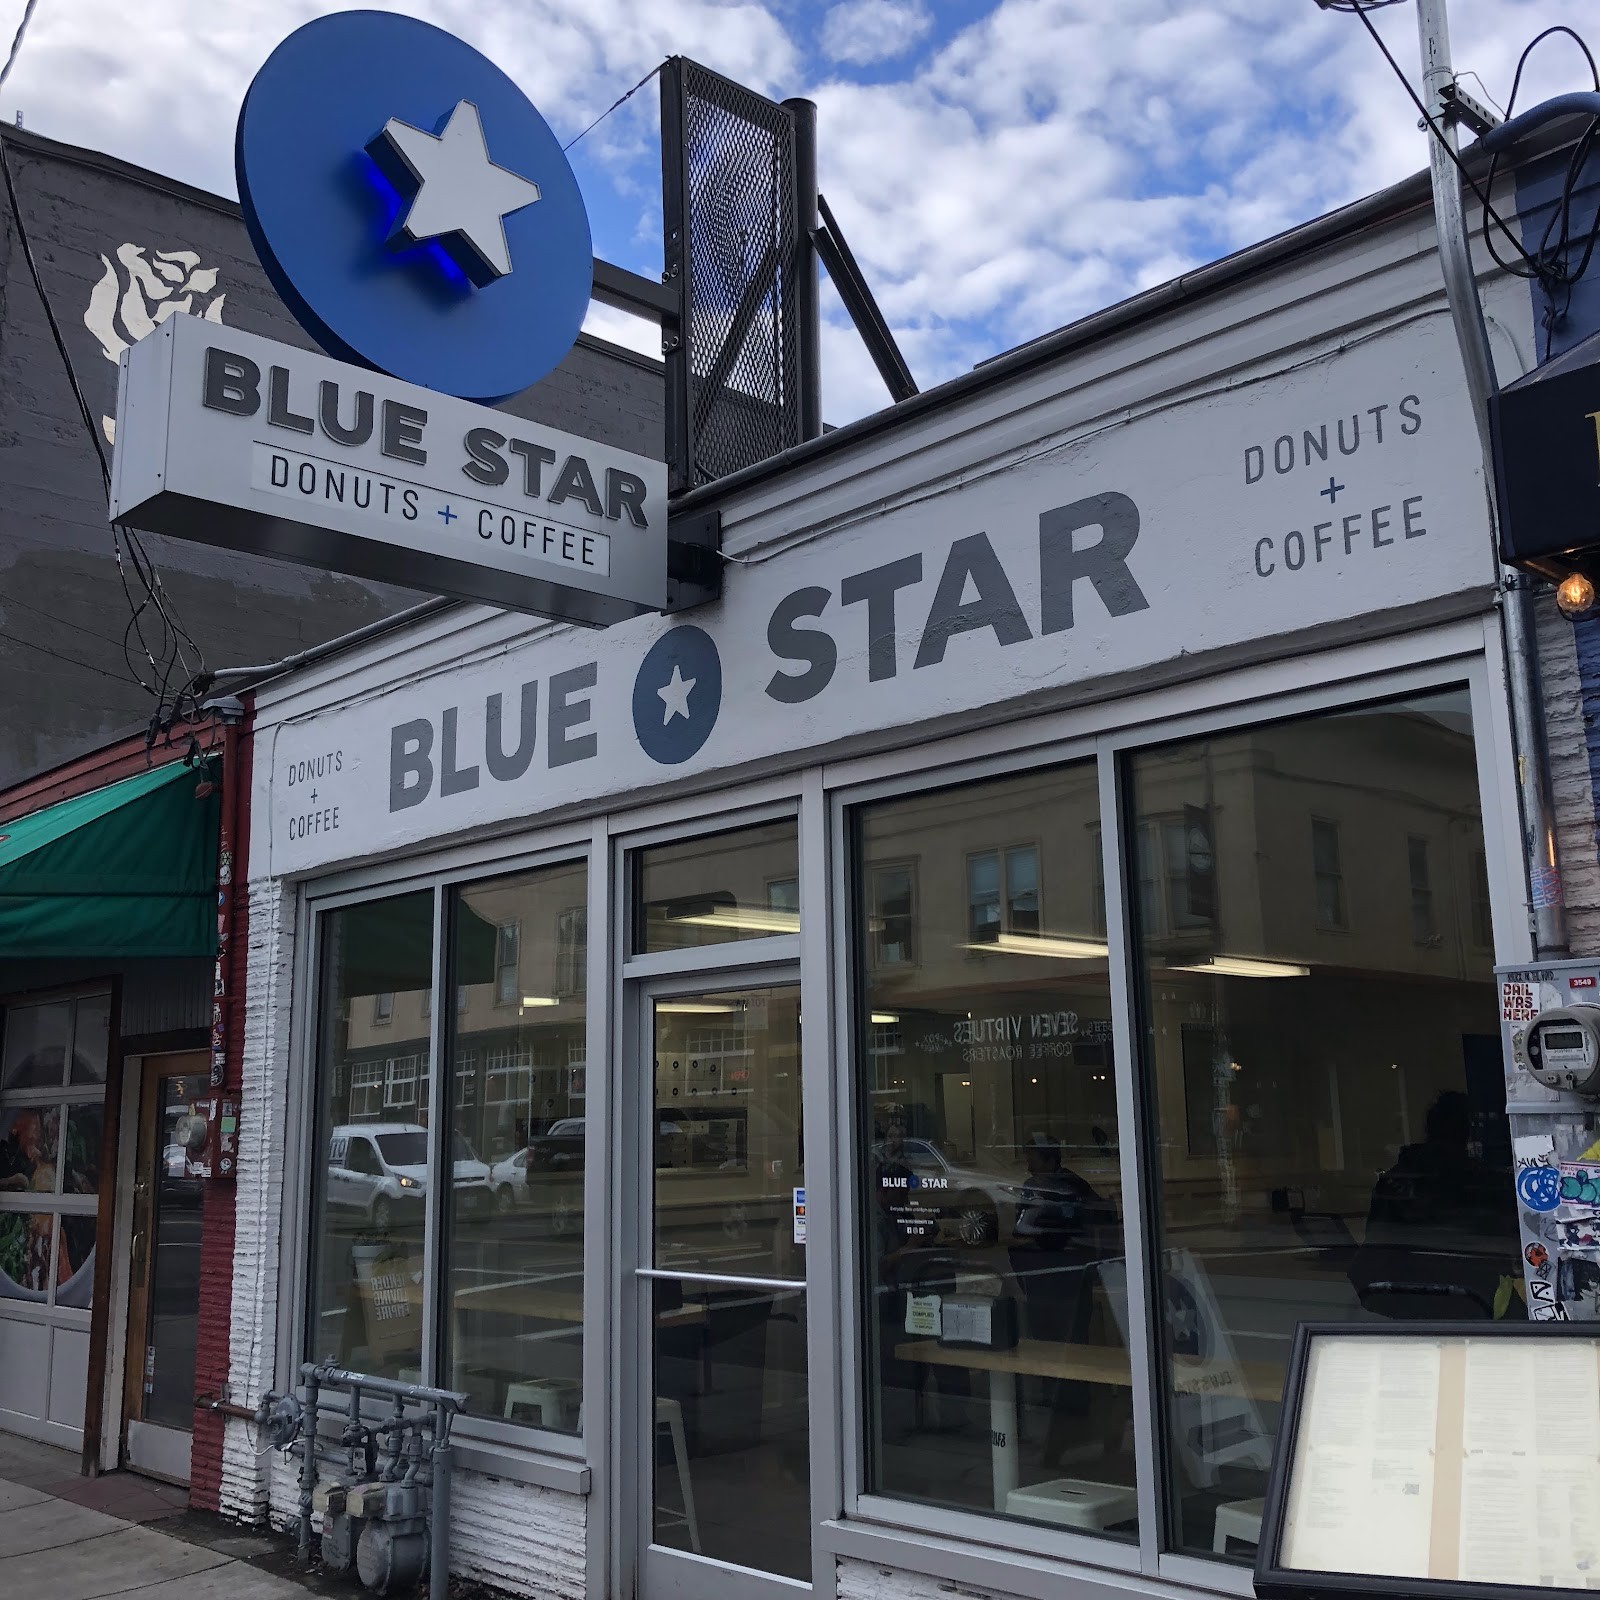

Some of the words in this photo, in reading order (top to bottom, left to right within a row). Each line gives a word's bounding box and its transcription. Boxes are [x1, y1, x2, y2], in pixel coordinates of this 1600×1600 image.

[203, 346, 428, 465] BLUE
[462, 427, 649, 528] STAR
[1244, 395, 1422, 485] DONUTS
[271, 454, 420, 522] DONUTS
[437, 504, 458, 525] +
[478, 509, 596, 567] COFFEE
[1320, 476, 1346, 504] +
[1254, 495, 1427, 578] COFFEE
[389, 661, 598, 813] BLUE
[765, 490, 1150, 704] STAR
[287, 748, 343, 788] DONUTS
[288, 806, 340, 841] COFFEE
[1503, 996, 1533, 1009] WAS
[882, 1177, 908, 1188] BLUE
[921, 1178, 948, 1189] STAR
